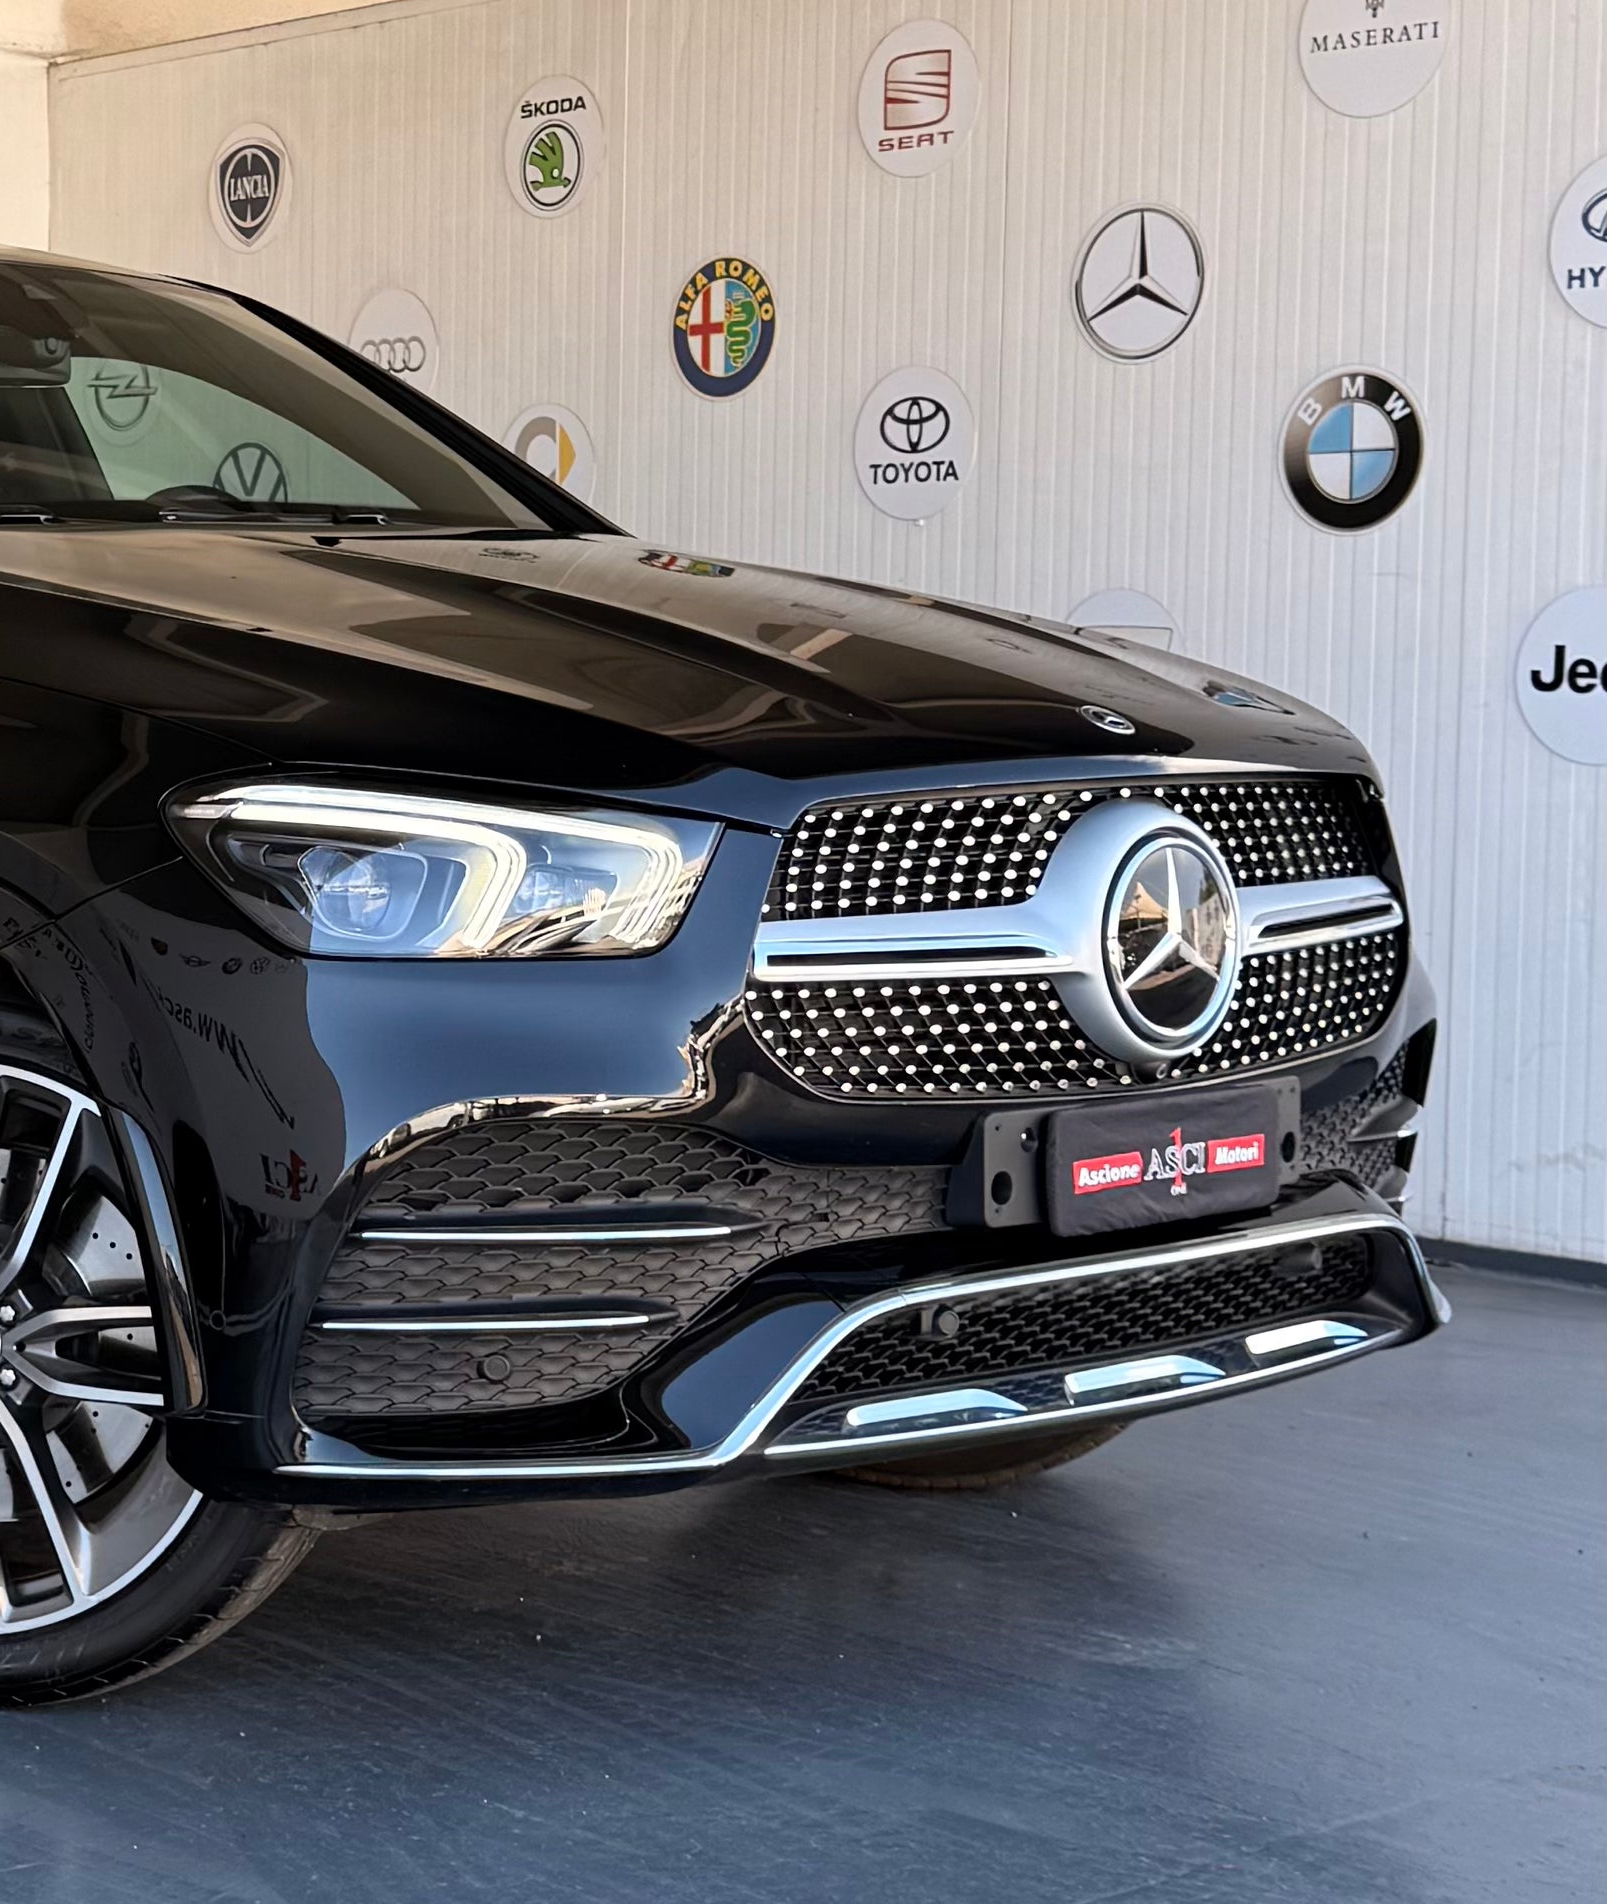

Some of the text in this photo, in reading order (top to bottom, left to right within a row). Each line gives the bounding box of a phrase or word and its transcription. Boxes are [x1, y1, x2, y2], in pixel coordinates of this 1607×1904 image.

[1310, 21, 1439, 53] MASERATI
[520, 96, 587, 119] ŠKODA
[878, 130, 955, 152] SEAT
[230, 174, 269, 201] LANCIA
[675, 260, 774, 330] ALFA ROMEO
[1296, 375, 1411, 427] BMW
[869, 460, 959, 485] TOYOTA
[1530, 644, 1607, 694] Je
[1077, 1162, 1141, 1187] Ascione
[1214, 1142, 1259, 1165] Motori
